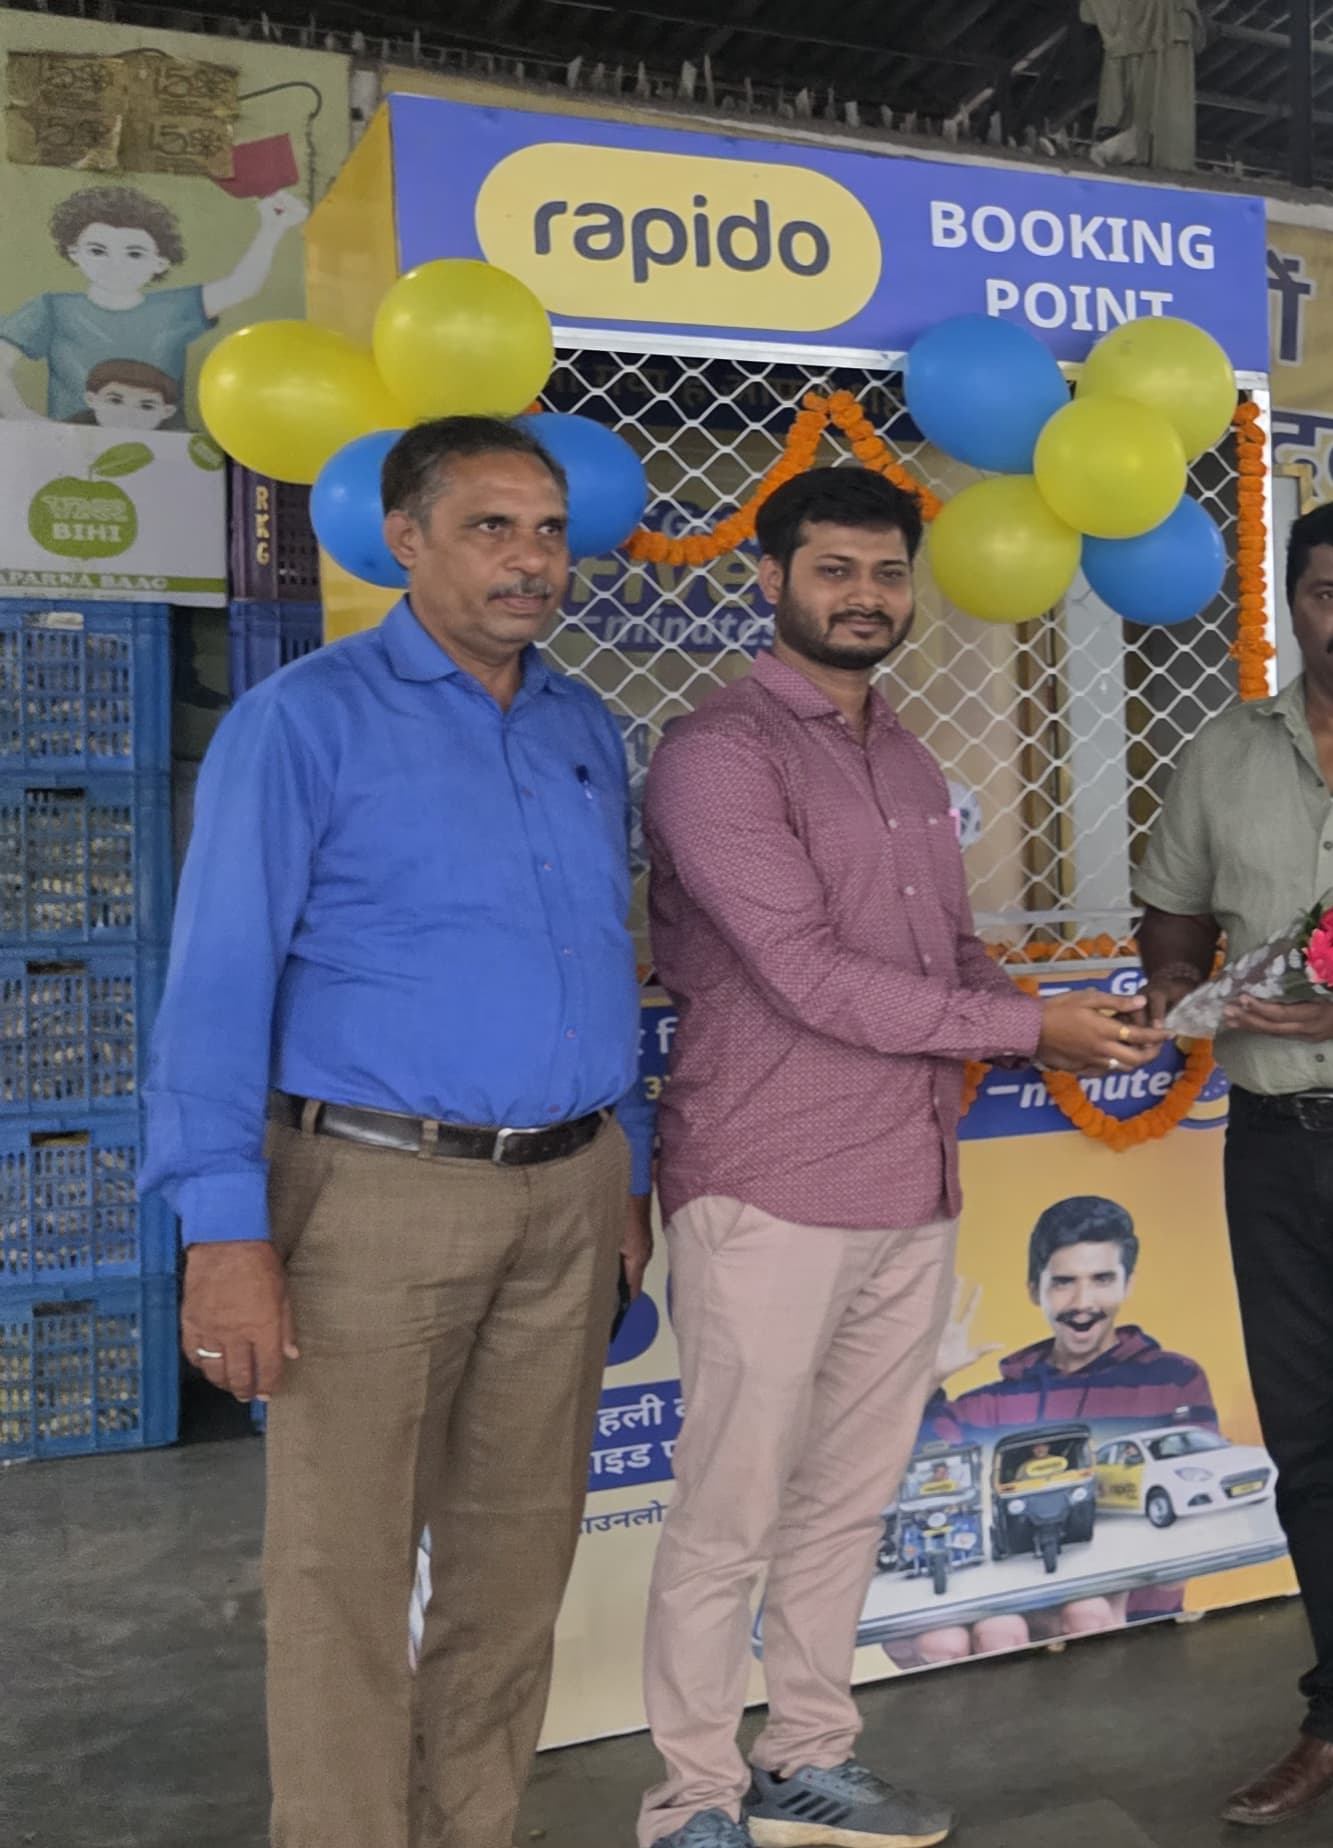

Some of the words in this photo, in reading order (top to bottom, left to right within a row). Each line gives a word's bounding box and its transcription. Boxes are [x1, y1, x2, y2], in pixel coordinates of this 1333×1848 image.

[533, 195, 831, 283] rapido
[930, 200, 1215, 269] BOOKING
[53, 523, 122, 543] BIHI
[597, 1393, 664, 1437] हली
